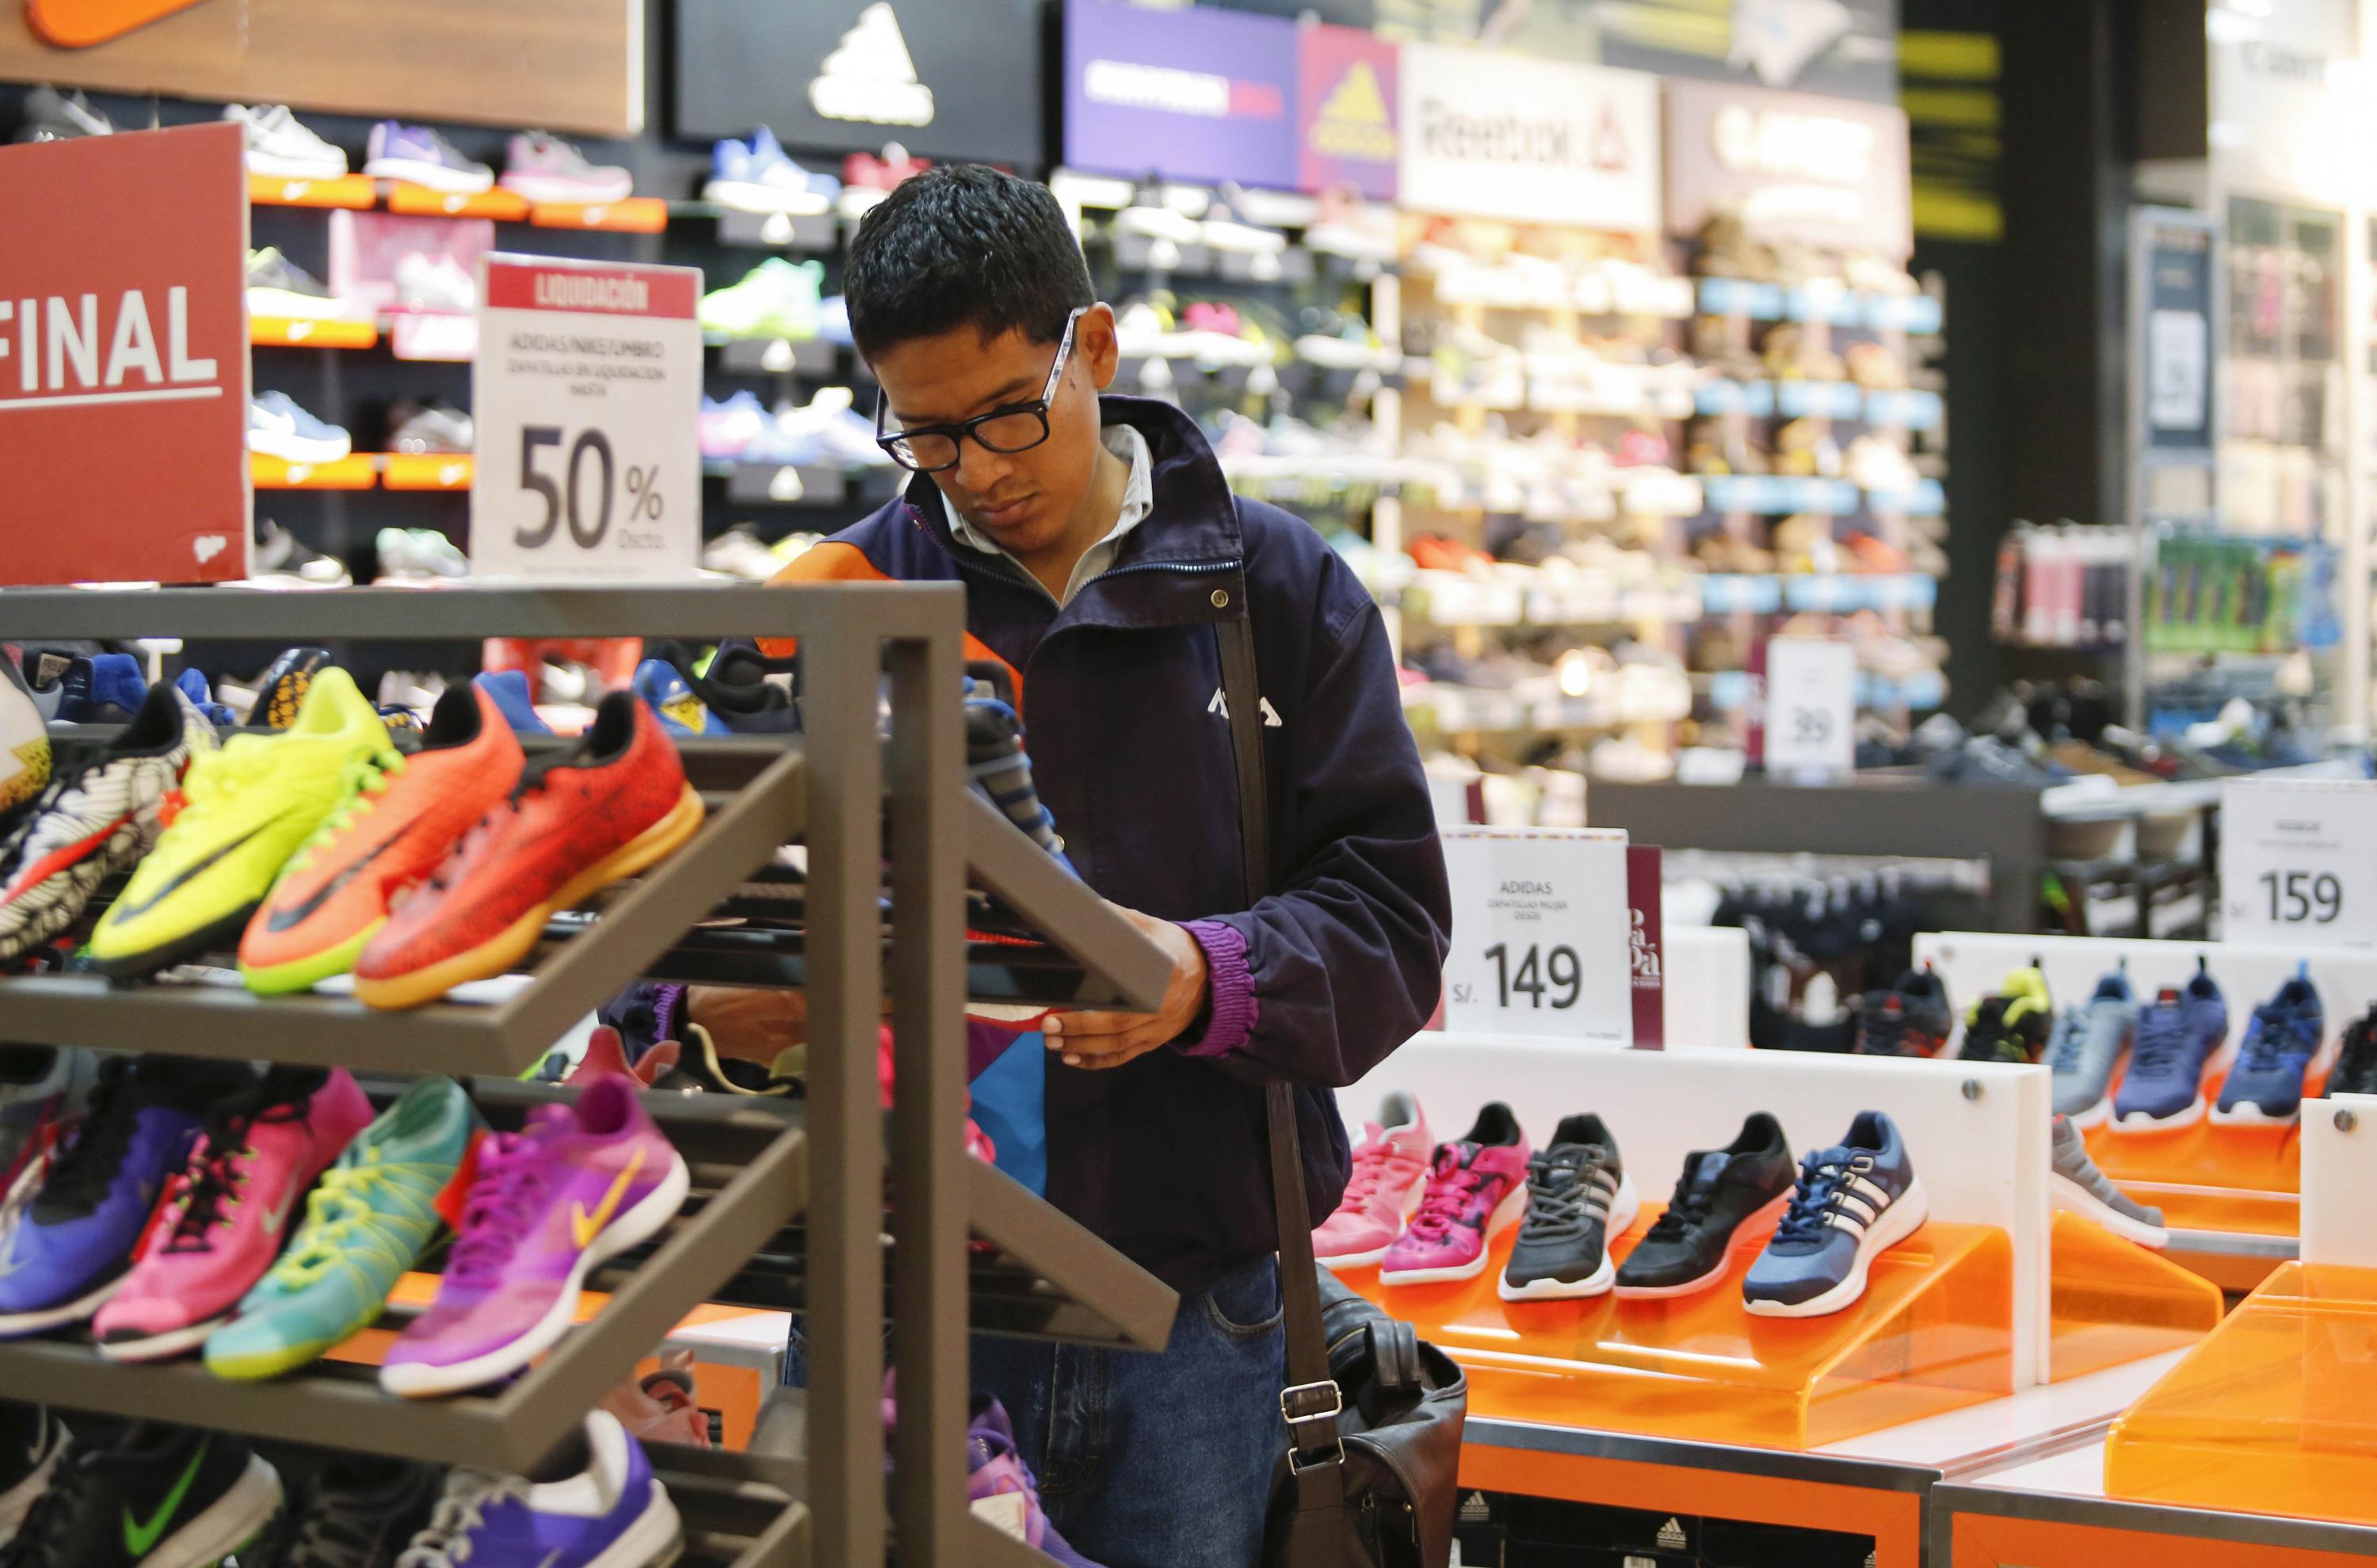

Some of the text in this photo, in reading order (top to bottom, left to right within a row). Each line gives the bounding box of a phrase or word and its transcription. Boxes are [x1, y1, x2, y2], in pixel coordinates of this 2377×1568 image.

[515, 425, 665, 550] 50 %
[1500, 880, 1553, 895] ADIDAS
[2260, 871, 2343, 923] 159
[1484, 942, 1582, 1009] 149
